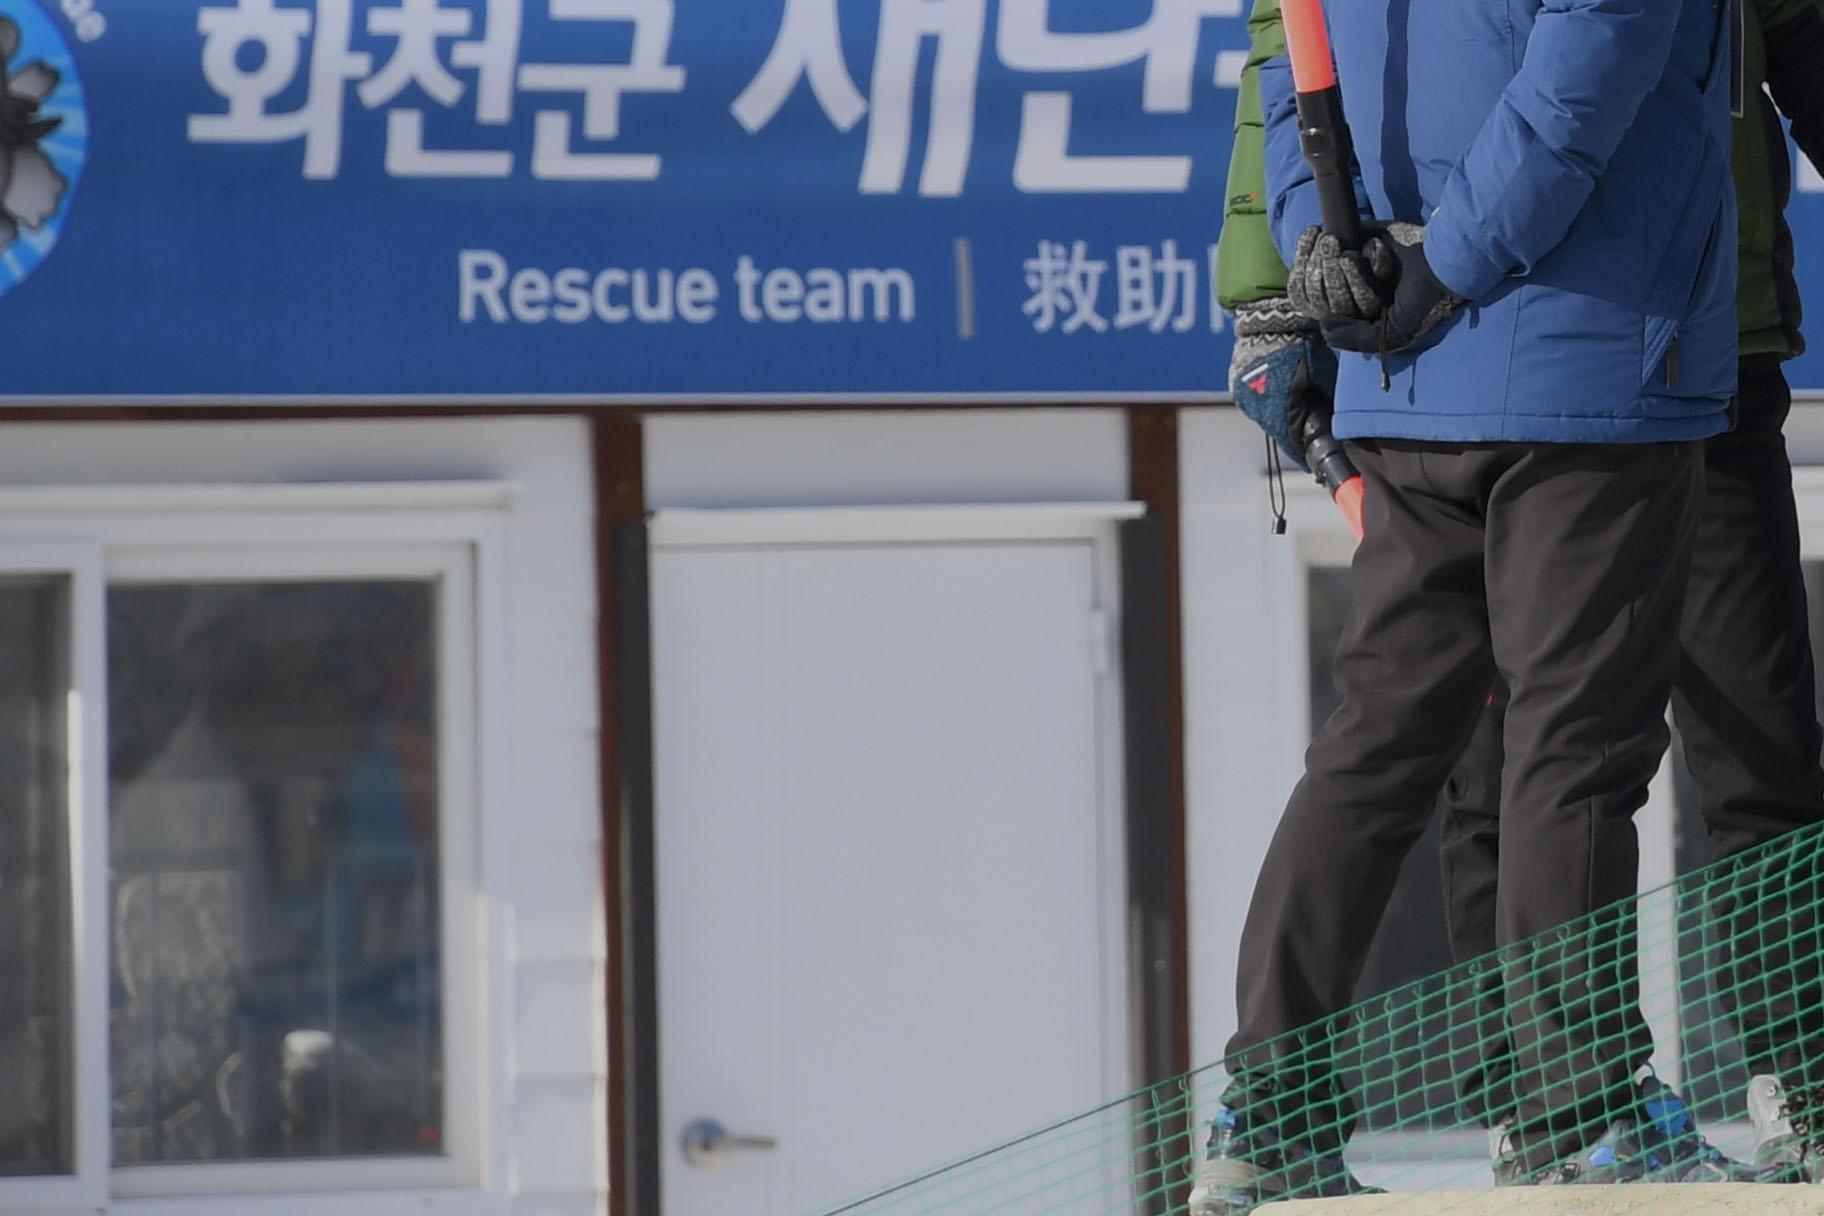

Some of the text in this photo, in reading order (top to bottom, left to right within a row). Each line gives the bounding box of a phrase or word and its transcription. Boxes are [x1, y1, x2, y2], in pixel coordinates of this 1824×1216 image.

[459, 250, 916, 323] Rescue team
[1022, 239, 1225, 335] 救助
